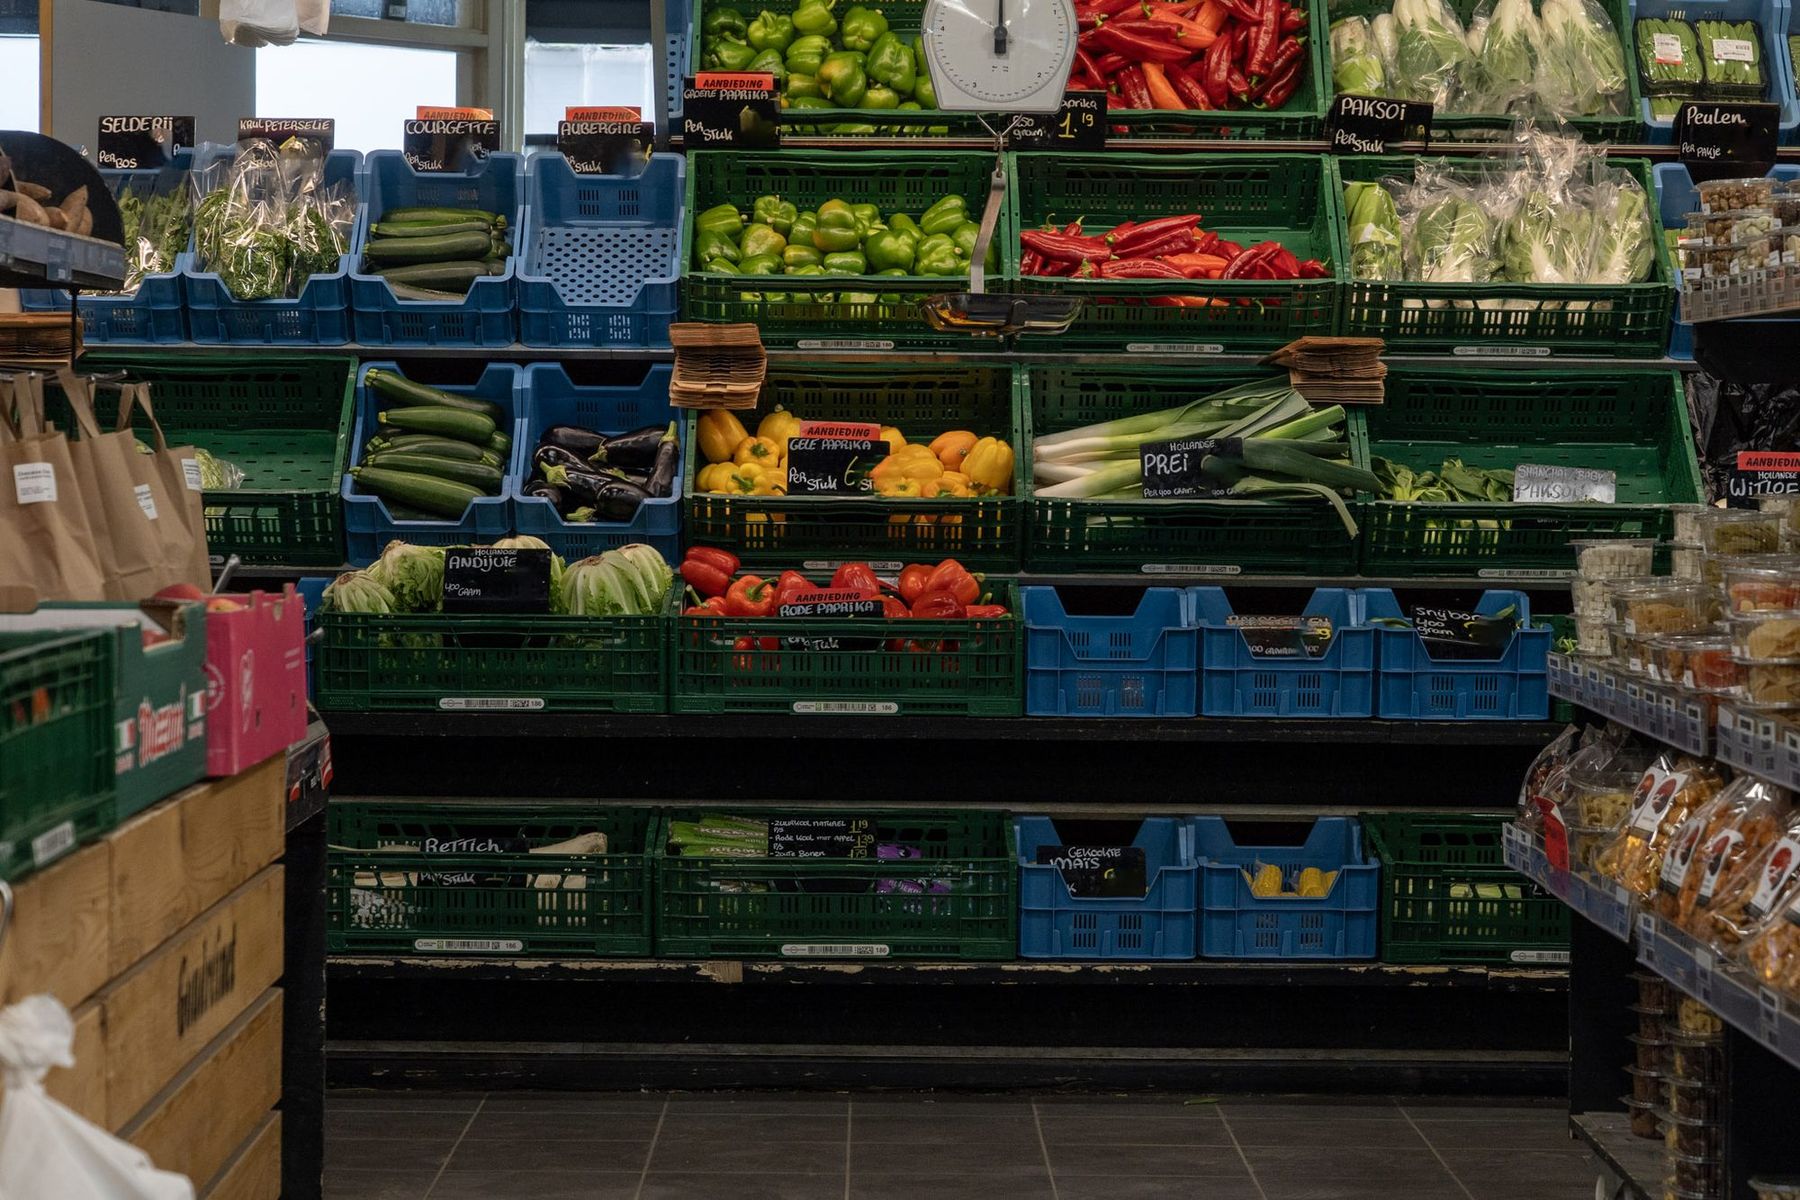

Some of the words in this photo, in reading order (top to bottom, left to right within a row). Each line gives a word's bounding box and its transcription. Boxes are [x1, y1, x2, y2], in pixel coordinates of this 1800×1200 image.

[703, 79, 763, 89] AANBIEDING
[572, 111, 632, 121] AANBIEDING
[1013, 128, 1044, 140] gram
[807, 427, 870, 438] AANBIEDING
[789, 438, 817, 450] GELE
[795, 592, 861, 603] AANBIEDING
[779, 603, 814, 617] RODE
